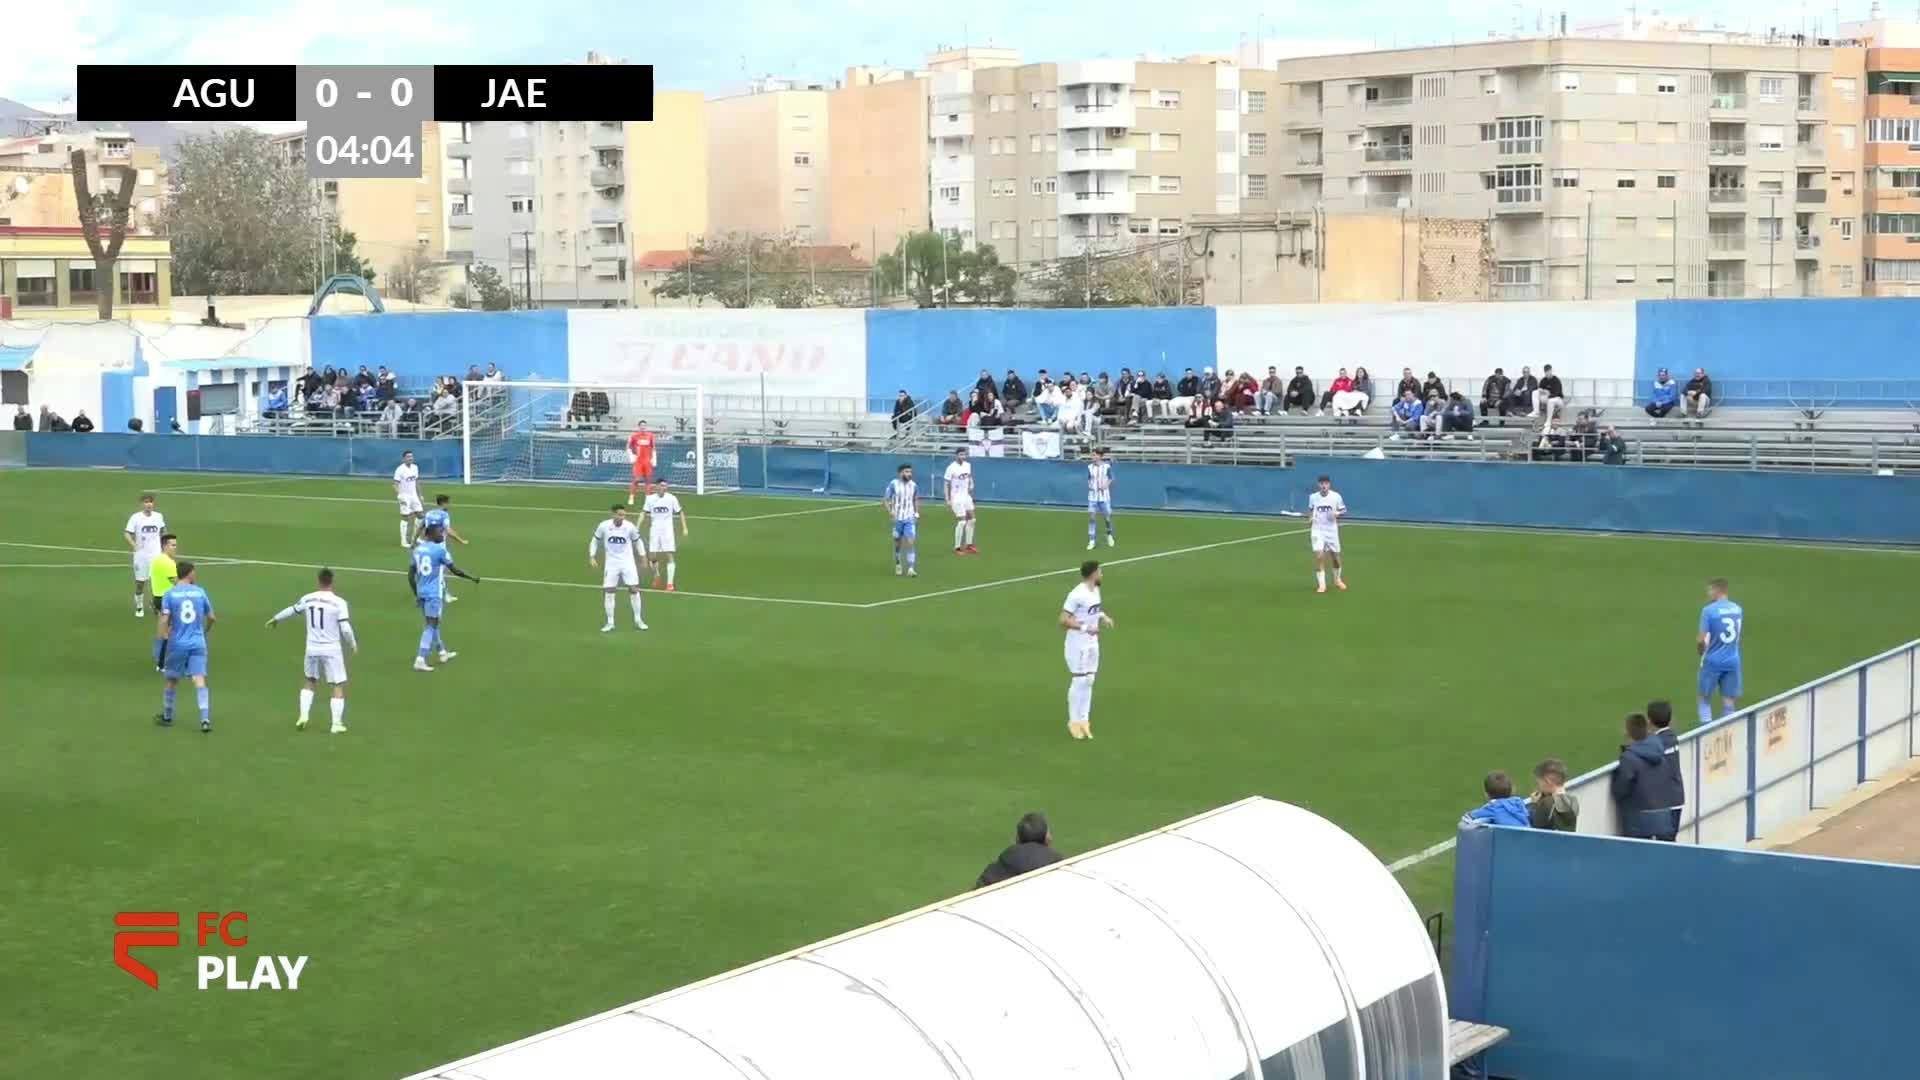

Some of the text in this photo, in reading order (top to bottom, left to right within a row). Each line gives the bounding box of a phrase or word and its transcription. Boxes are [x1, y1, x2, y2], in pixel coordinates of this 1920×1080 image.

[414, 554, 433, 576] 18
[180, 599, 196, 624] 8
[308, 606, 325, 630] 11
[1719, 617, 1742, 644] 31
